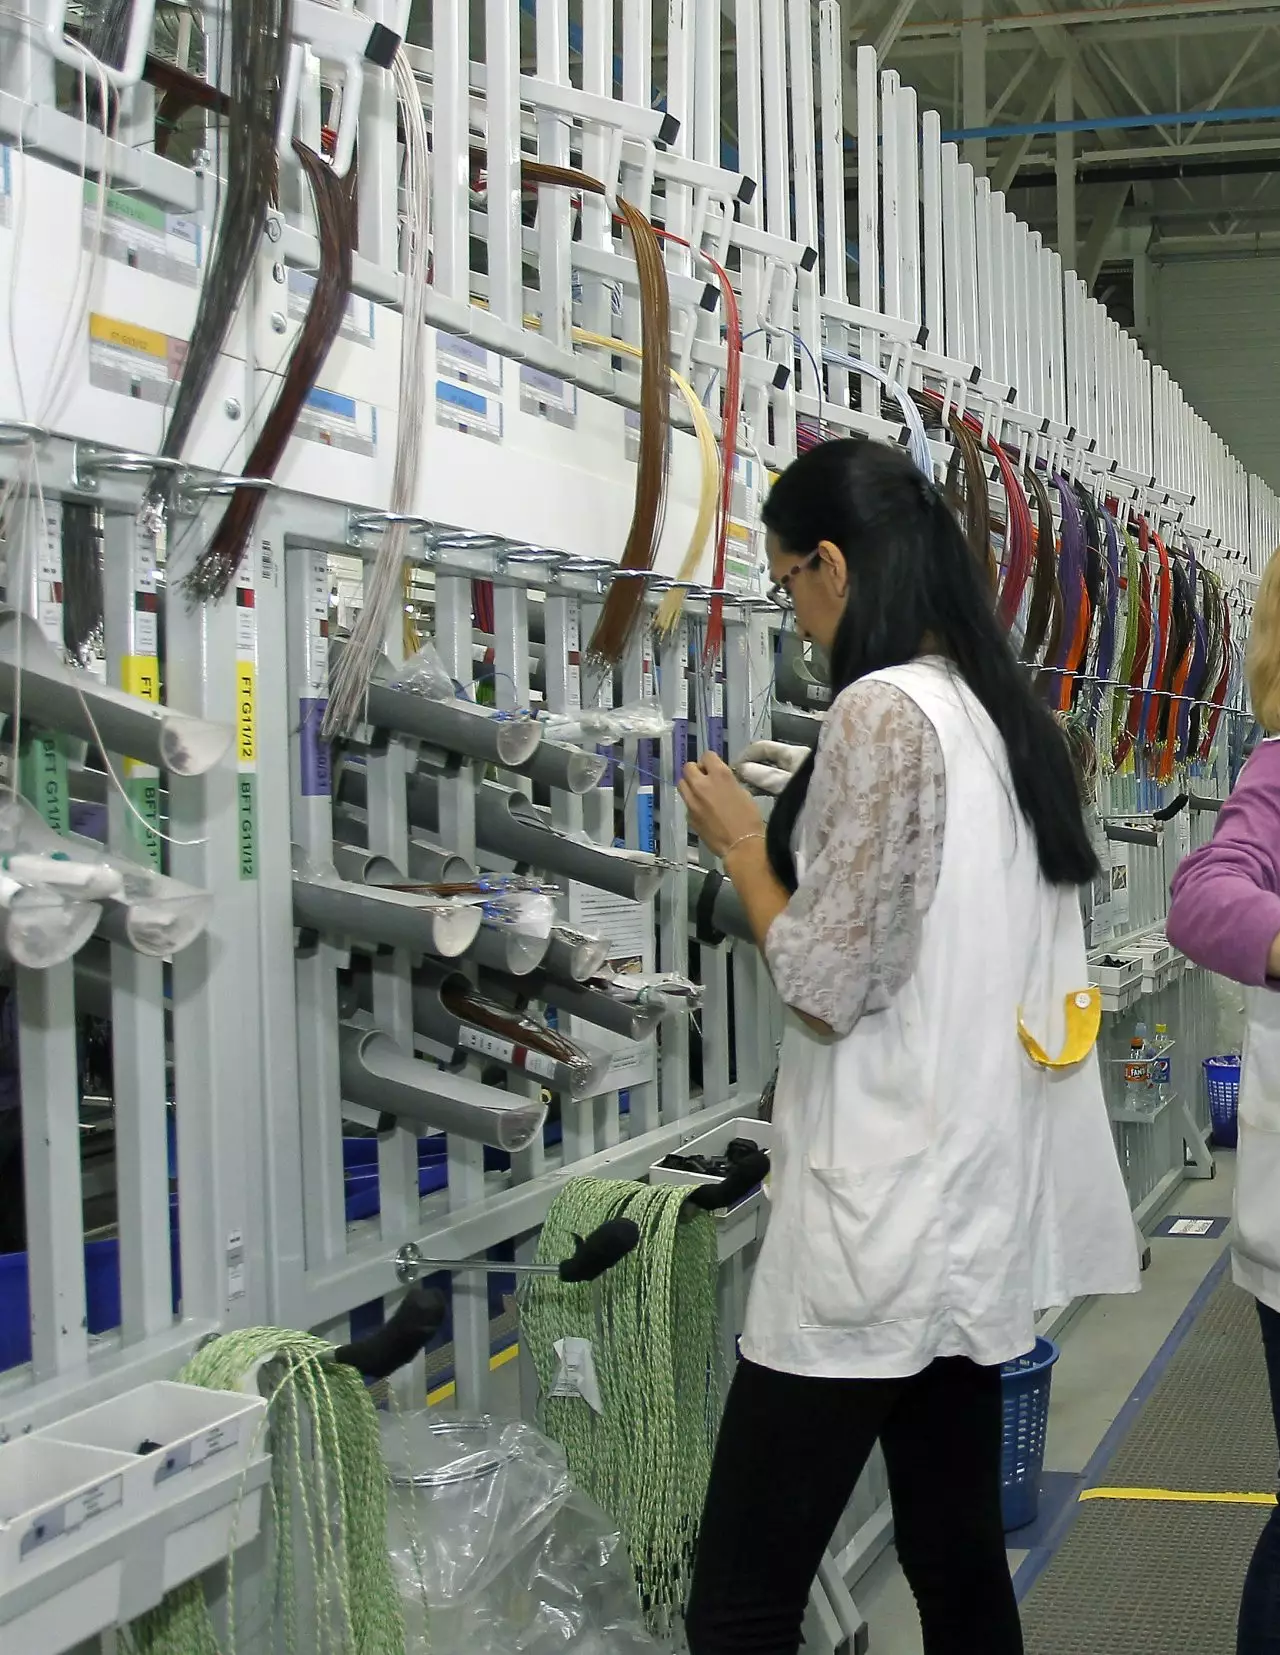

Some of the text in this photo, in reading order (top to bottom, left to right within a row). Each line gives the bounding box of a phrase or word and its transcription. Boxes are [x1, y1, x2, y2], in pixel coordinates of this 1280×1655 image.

[141, 676, 151, 698] FT
[241, 676, 252, 758] FT G11/12
[43, 739, 58, 777] BFT
[145, 786, 156, 825] BFT
[241, 782, 252, 877] BFT G11/12
